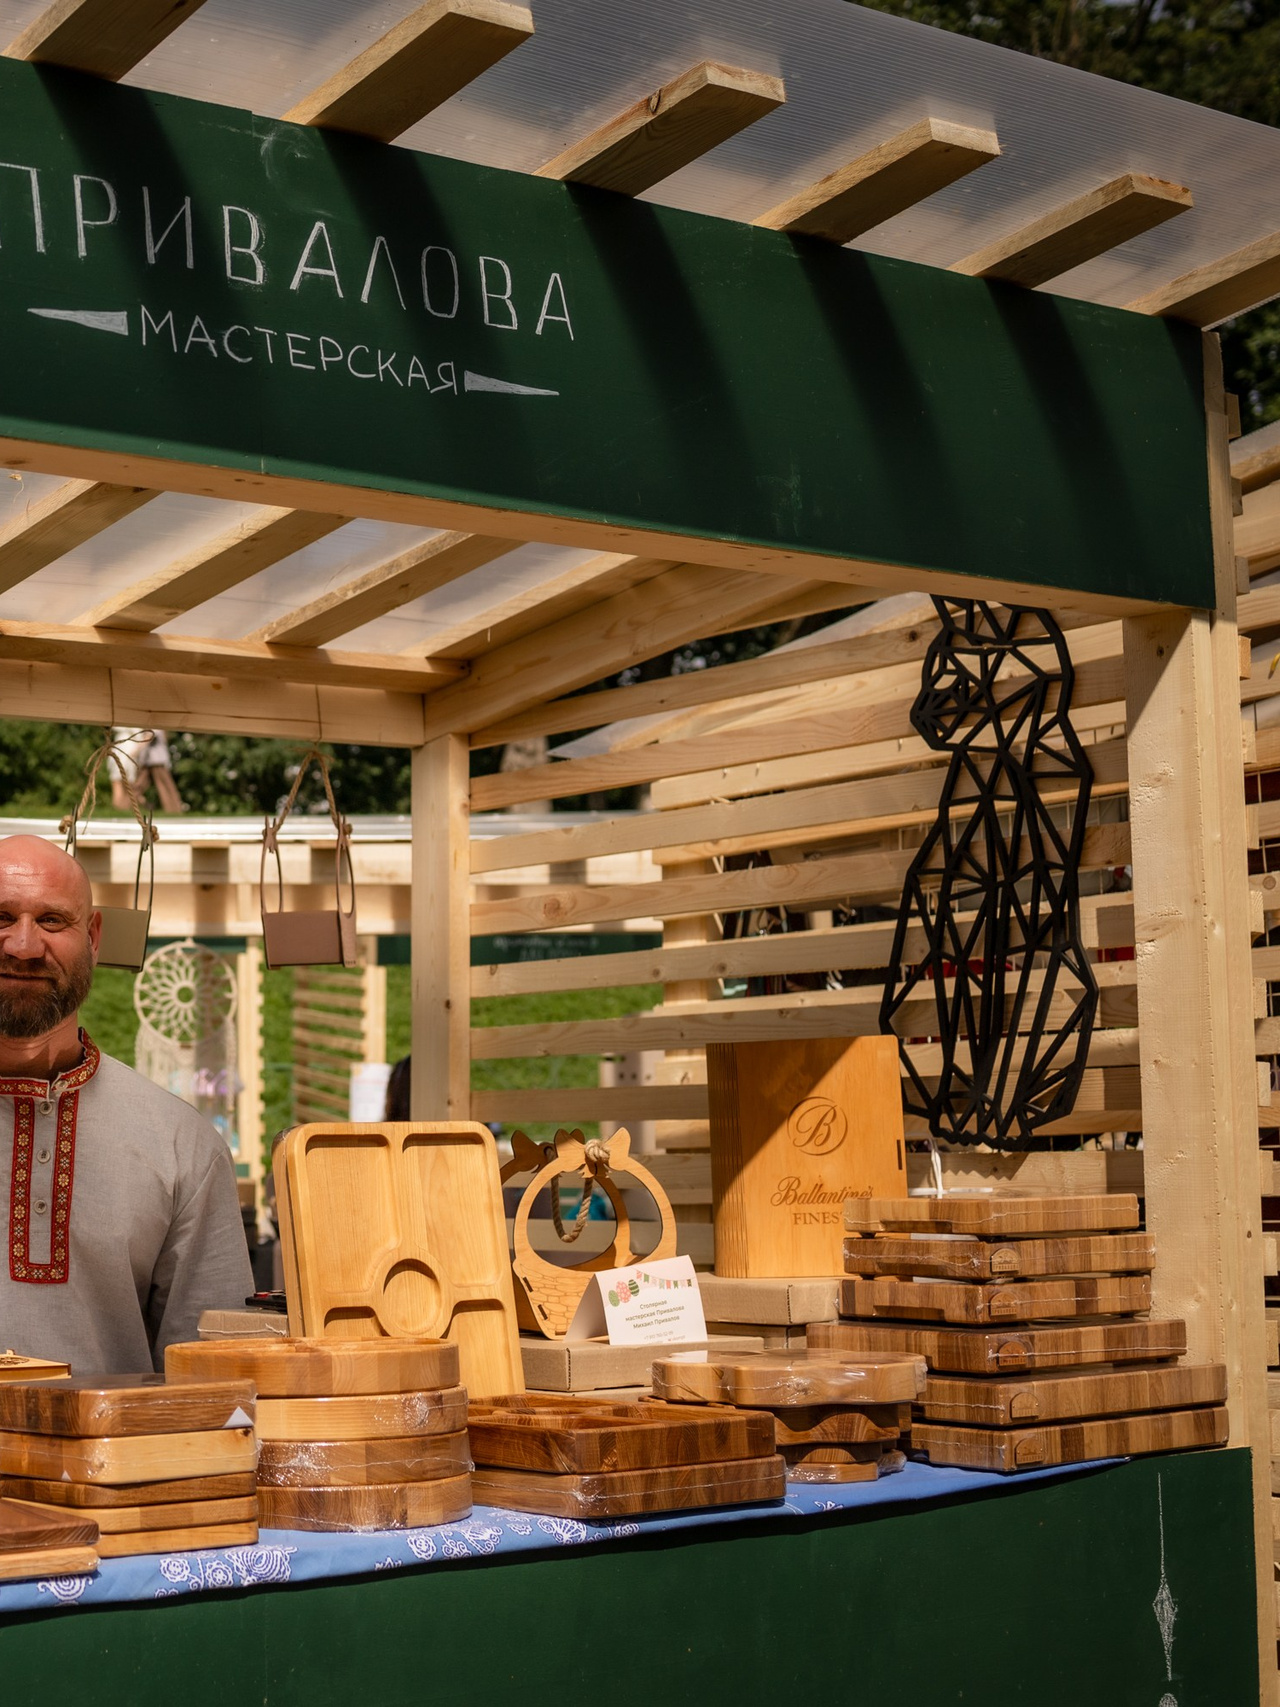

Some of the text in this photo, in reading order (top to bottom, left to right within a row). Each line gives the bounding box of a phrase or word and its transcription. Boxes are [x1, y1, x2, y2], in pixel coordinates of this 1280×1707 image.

[141, 304, 458, 395] МАСТЕРСКАЯ
[793, 1211, 843, 1225] FINES
[639, 1300, 667, 1310] Столярная
[625, 1305, 685, 1321] мастерская Привалова
[633, 1315, 680, 1329] Михаил Привалов
